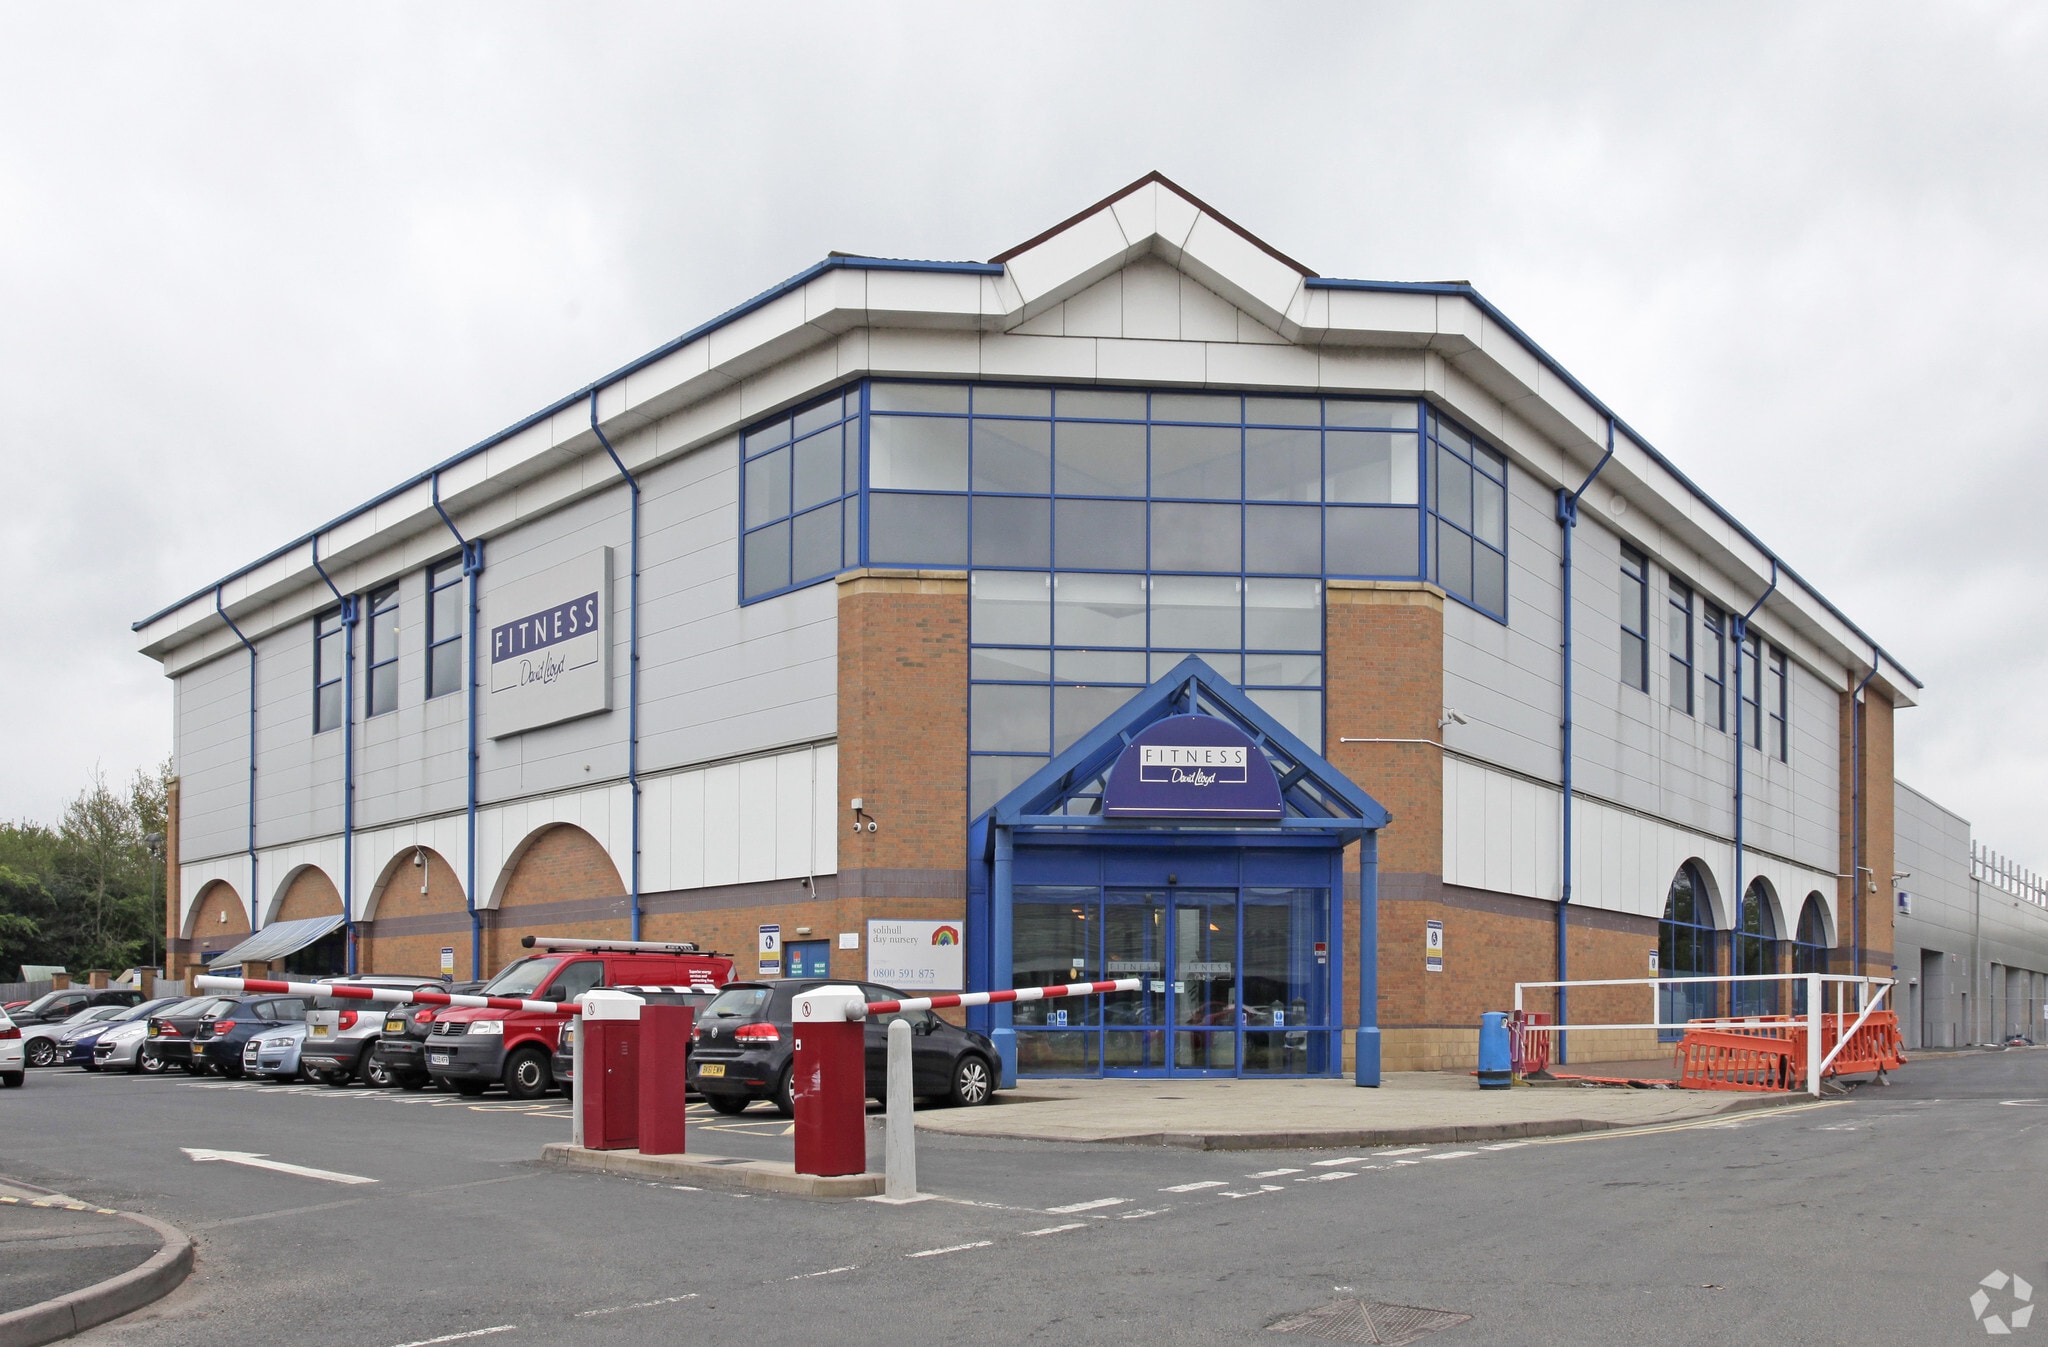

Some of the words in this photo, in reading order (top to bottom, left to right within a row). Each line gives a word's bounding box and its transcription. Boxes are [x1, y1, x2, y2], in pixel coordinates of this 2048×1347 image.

[495, 599, 594, 658] FITNESS
[520, 658, 544, 687] David
[543, 651, 566, 685] Lloyd
[1145, 749, 1243, 764] FITNESS
[1171, 767, 1195, 784] David
[1194, 768, 1217, 787] Lloyd
[873, 925, 902, 935] solihull
[873, 935, 887, 945] day
[889, 937, 919, 945] nursery
[1110, 963, 1159, 971] FITNESS
[1182, 963, 1230, 971] ITNESS
[873, 968, 895, 978] 0800
[898, 969, 915, 978] 591
[918, 969, 935, 978] 875
